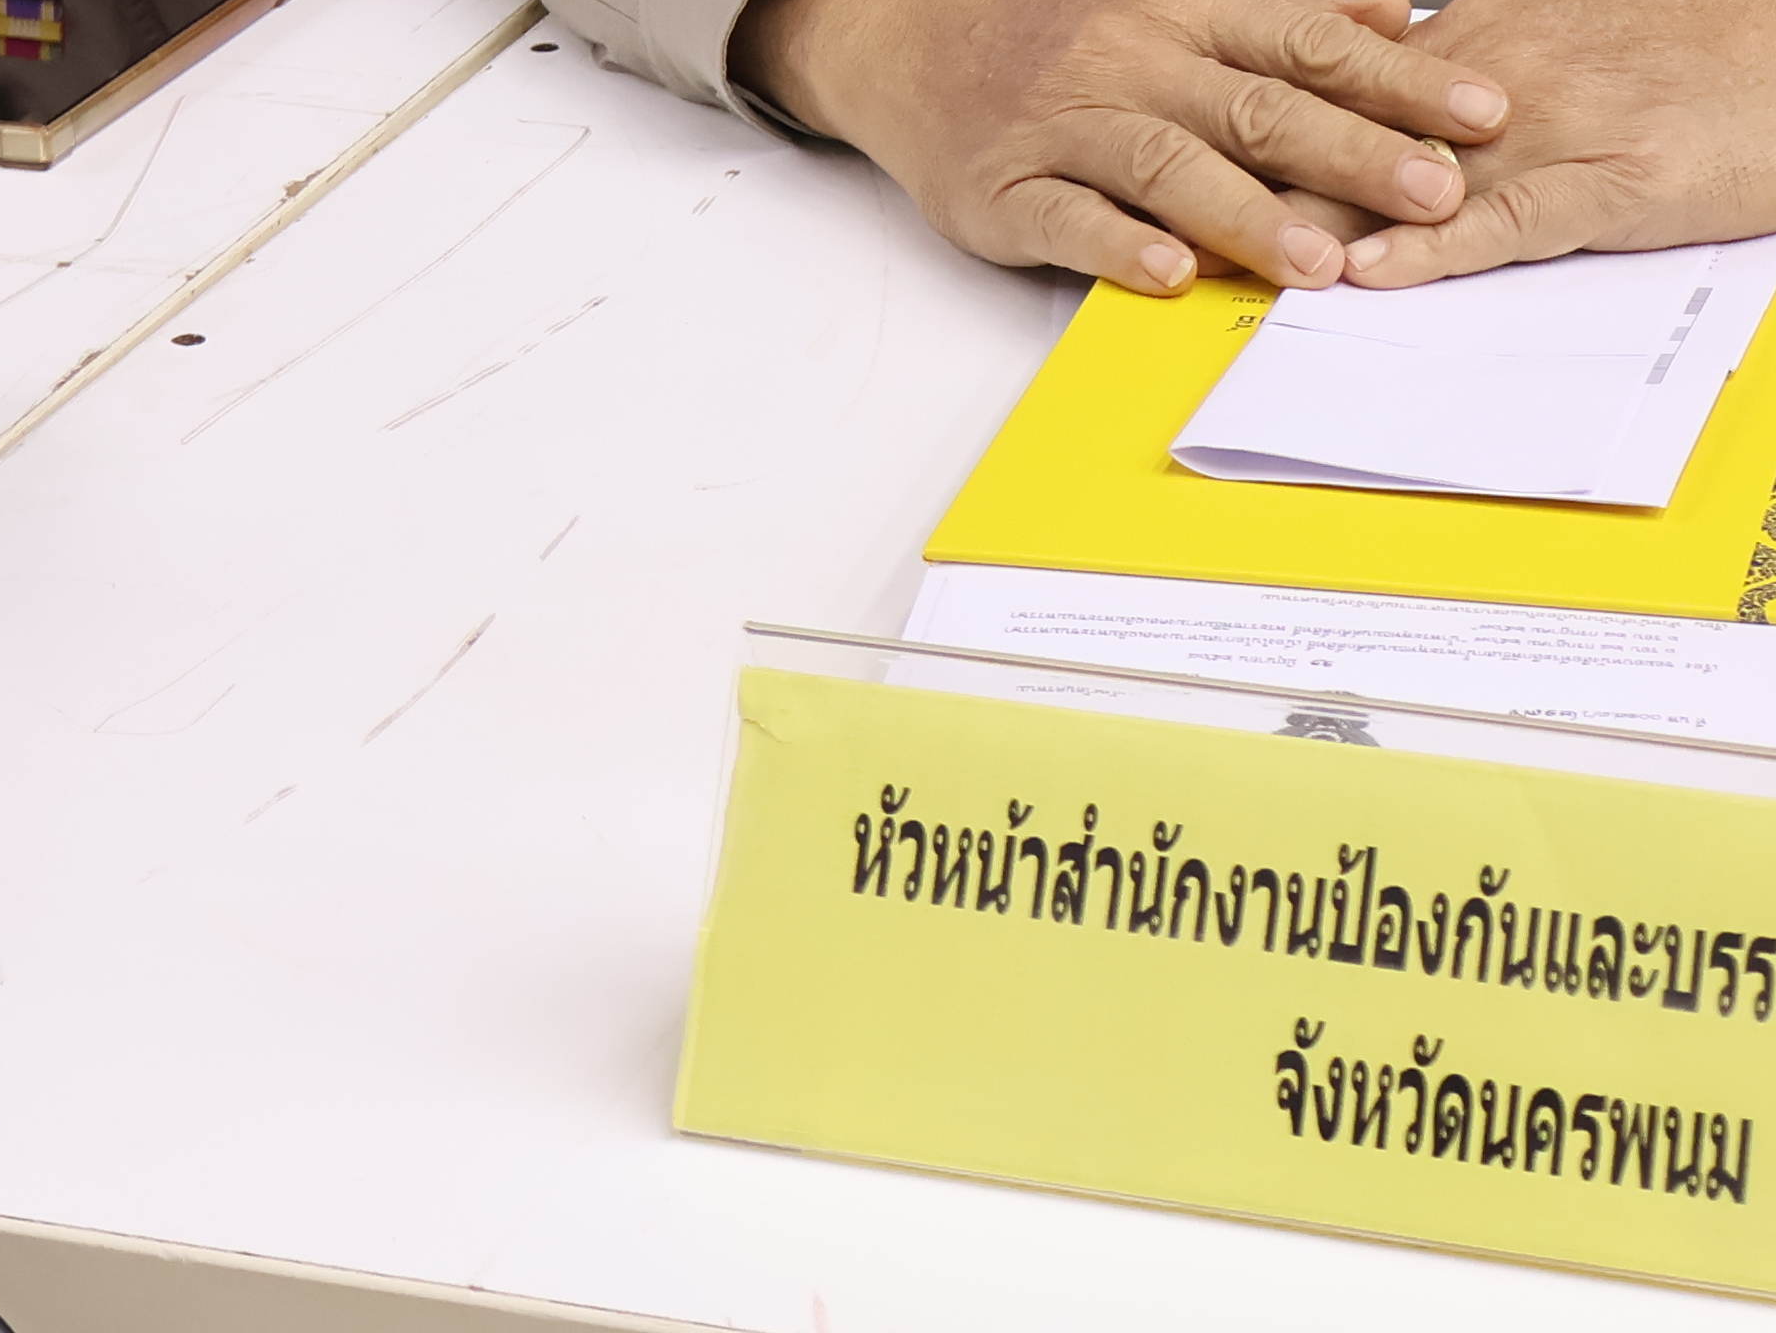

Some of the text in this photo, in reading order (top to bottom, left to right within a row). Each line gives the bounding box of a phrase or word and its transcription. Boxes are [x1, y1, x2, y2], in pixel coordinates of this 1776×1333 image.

[1686, 663, 1717, 674] เรื่อง
[1274, 1015, 1752, 1204] จังหวัดนครพนม
